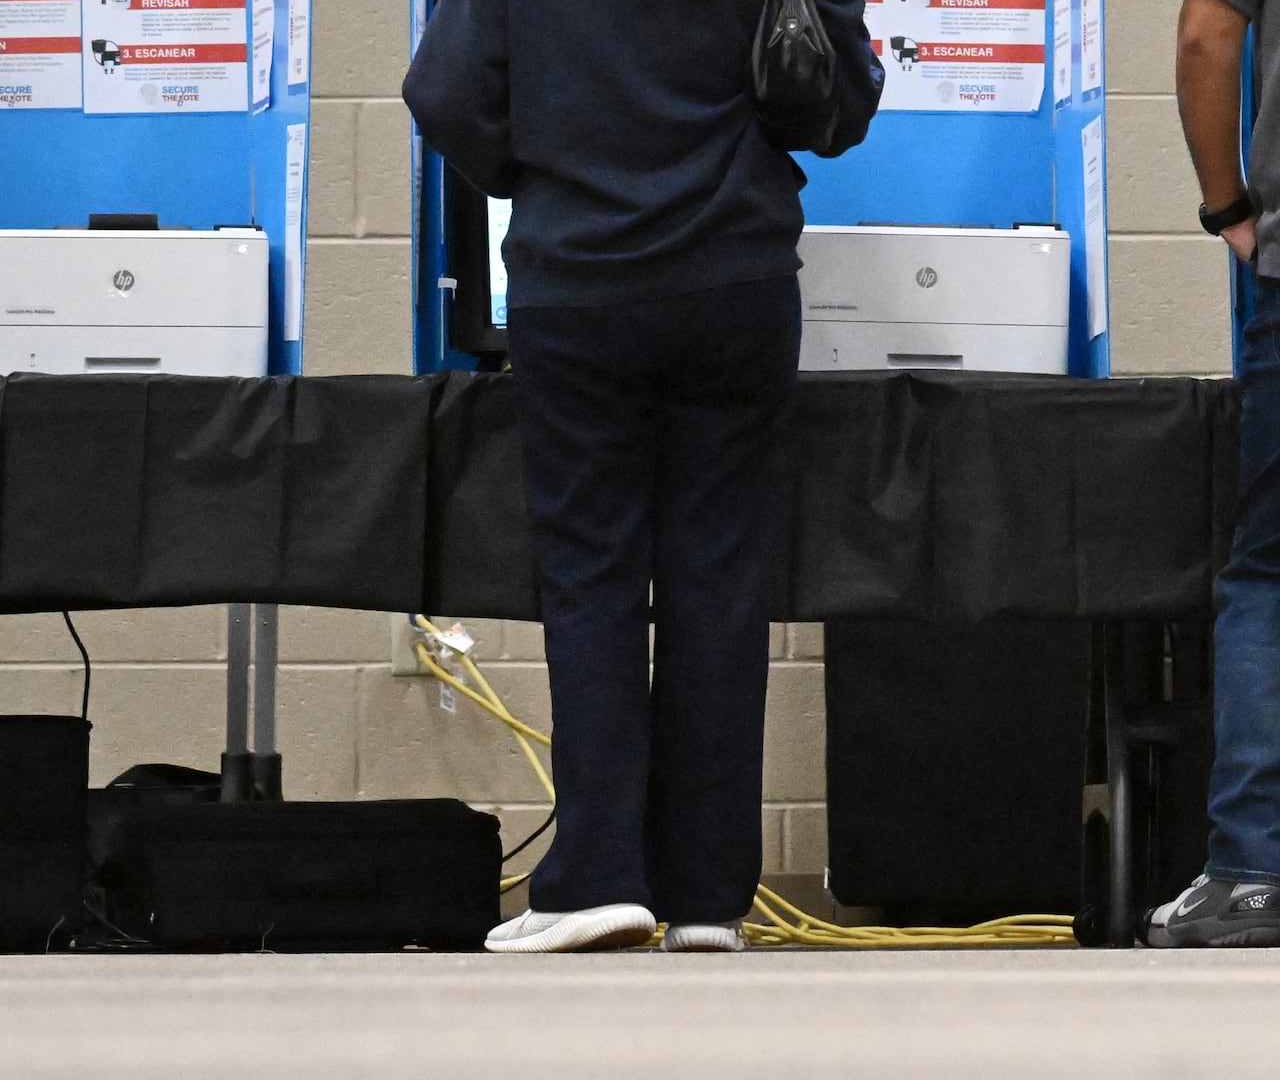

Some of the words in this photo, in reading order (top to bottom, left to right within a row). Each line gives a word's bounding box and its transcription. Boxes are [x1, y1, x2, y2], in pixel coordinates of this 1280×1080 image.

[122, 49, 132, 58] 3.
[135, 48, 195, 58] ESCANEAR
[921, 47, 930, 56] 3.
[933, 47, 993, 57] ESCANEAR
[0, 85, 32, 94] ECURE
[161, 85, 199, 94] SECURE
[959, 84, 995, 92] SECURE
[113, 270, 135, 291] hp
[916, 267, 938, 288] hp
